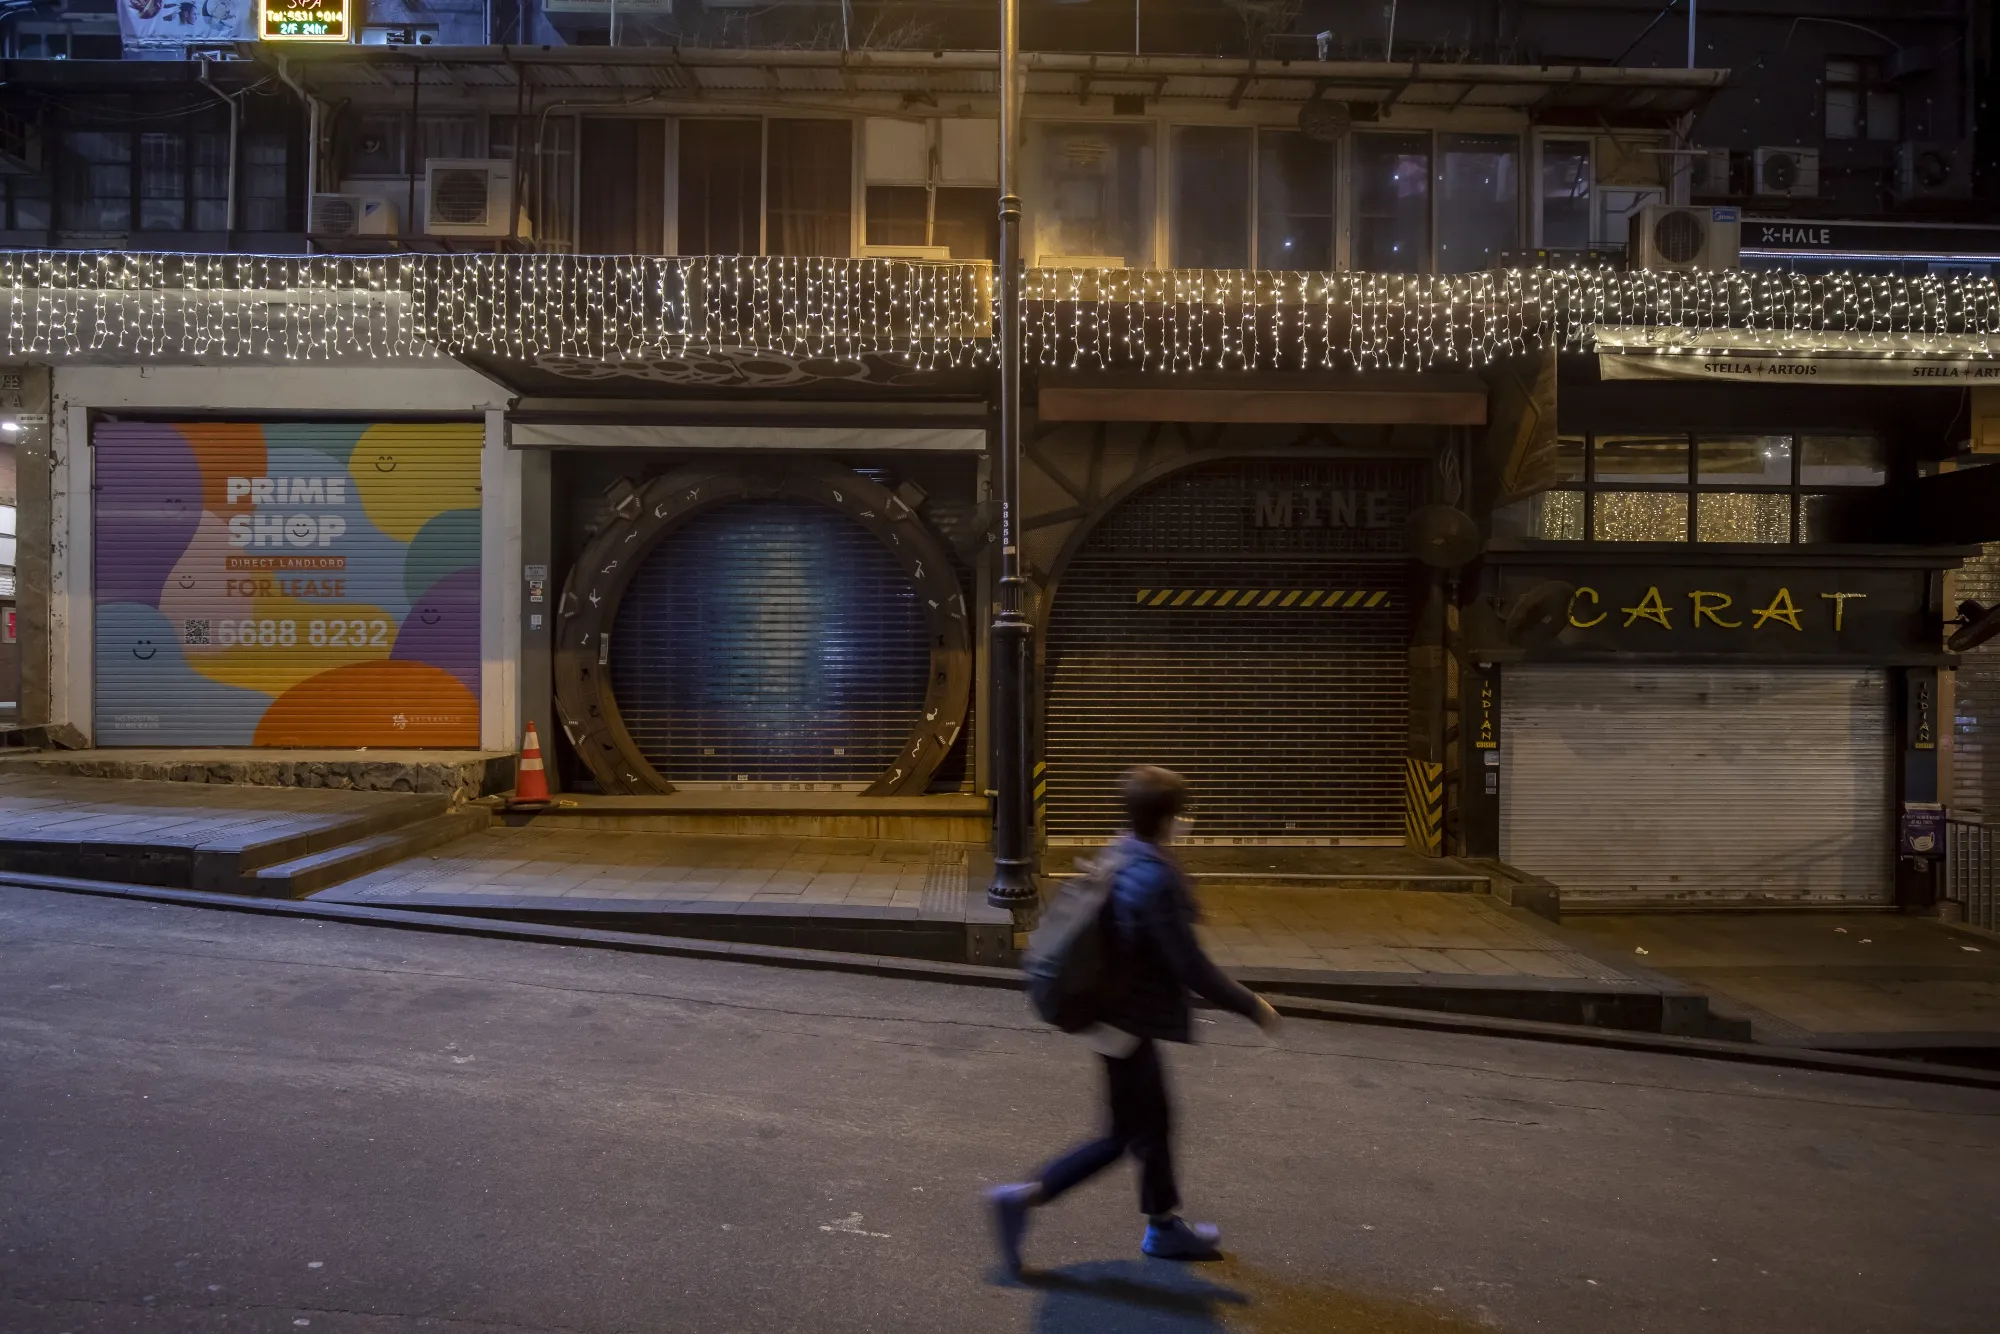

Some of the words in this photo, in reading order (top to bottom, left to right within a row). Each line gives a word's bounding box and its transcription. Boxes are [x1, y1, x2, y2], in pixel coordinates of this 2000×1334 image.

[280, 23, 298, 34] 2/F
[303, 23, 328, 34] 24hr
[1762, 227, 1830, 244] X-HALE
[1704, 363, 1752, 374] STELLA
[1768, 364, 1818, 375] ARTOIS
[1912, 366, 1959, 377] STELLA
[227, 476, 346, 504] PRIME
[1254, 490, 1391, 528] MINE
[227, 514, 346, 547] SHOP
[231, 559, 274, 567] DIRECT
[280, 559, 344, 567] LANDLORD
[226, 579, 272, 597] FOR
[281, 579, 346, 597] LEASE
[1567, 587, 1867, 631] CARAT
[218, 619, 298, 647] 6688
[308, 619, 388, 647] 8232
[1481, 680, 1492, 740] INDIAN
[1920, 682, 1930, 741] INDIAN
